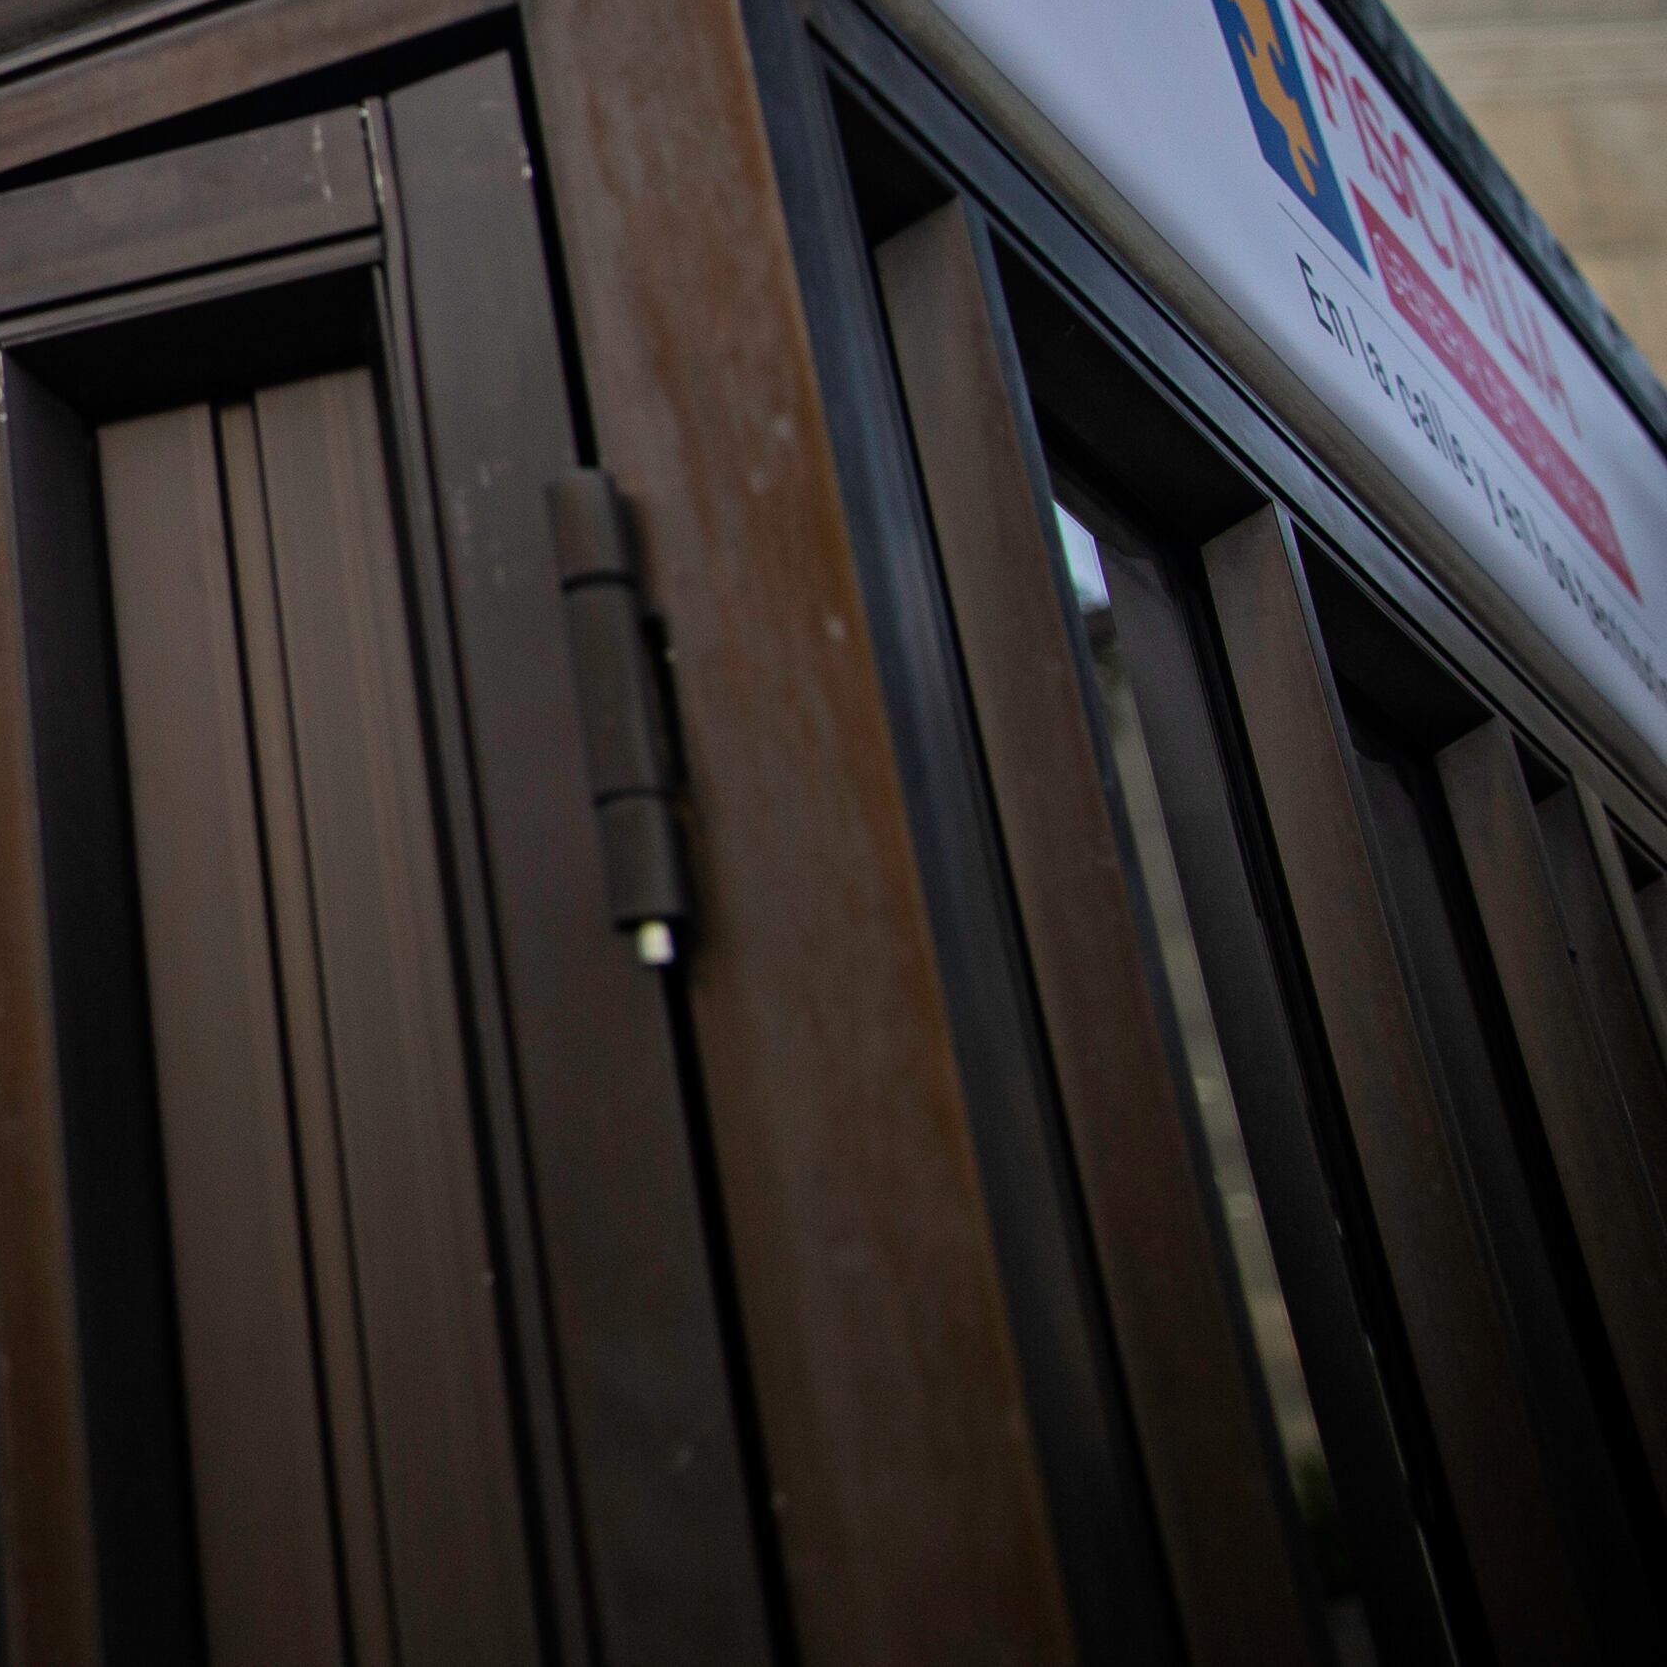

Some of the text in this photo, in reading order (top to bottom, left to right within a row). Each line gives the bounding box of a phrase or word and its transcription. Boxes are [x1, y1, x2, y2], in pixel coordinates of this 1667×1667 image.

[1295, 252, 1354, 359] En
[1347, 304, 1394, 401] la
[1395, 372, 1473, 488] calle
